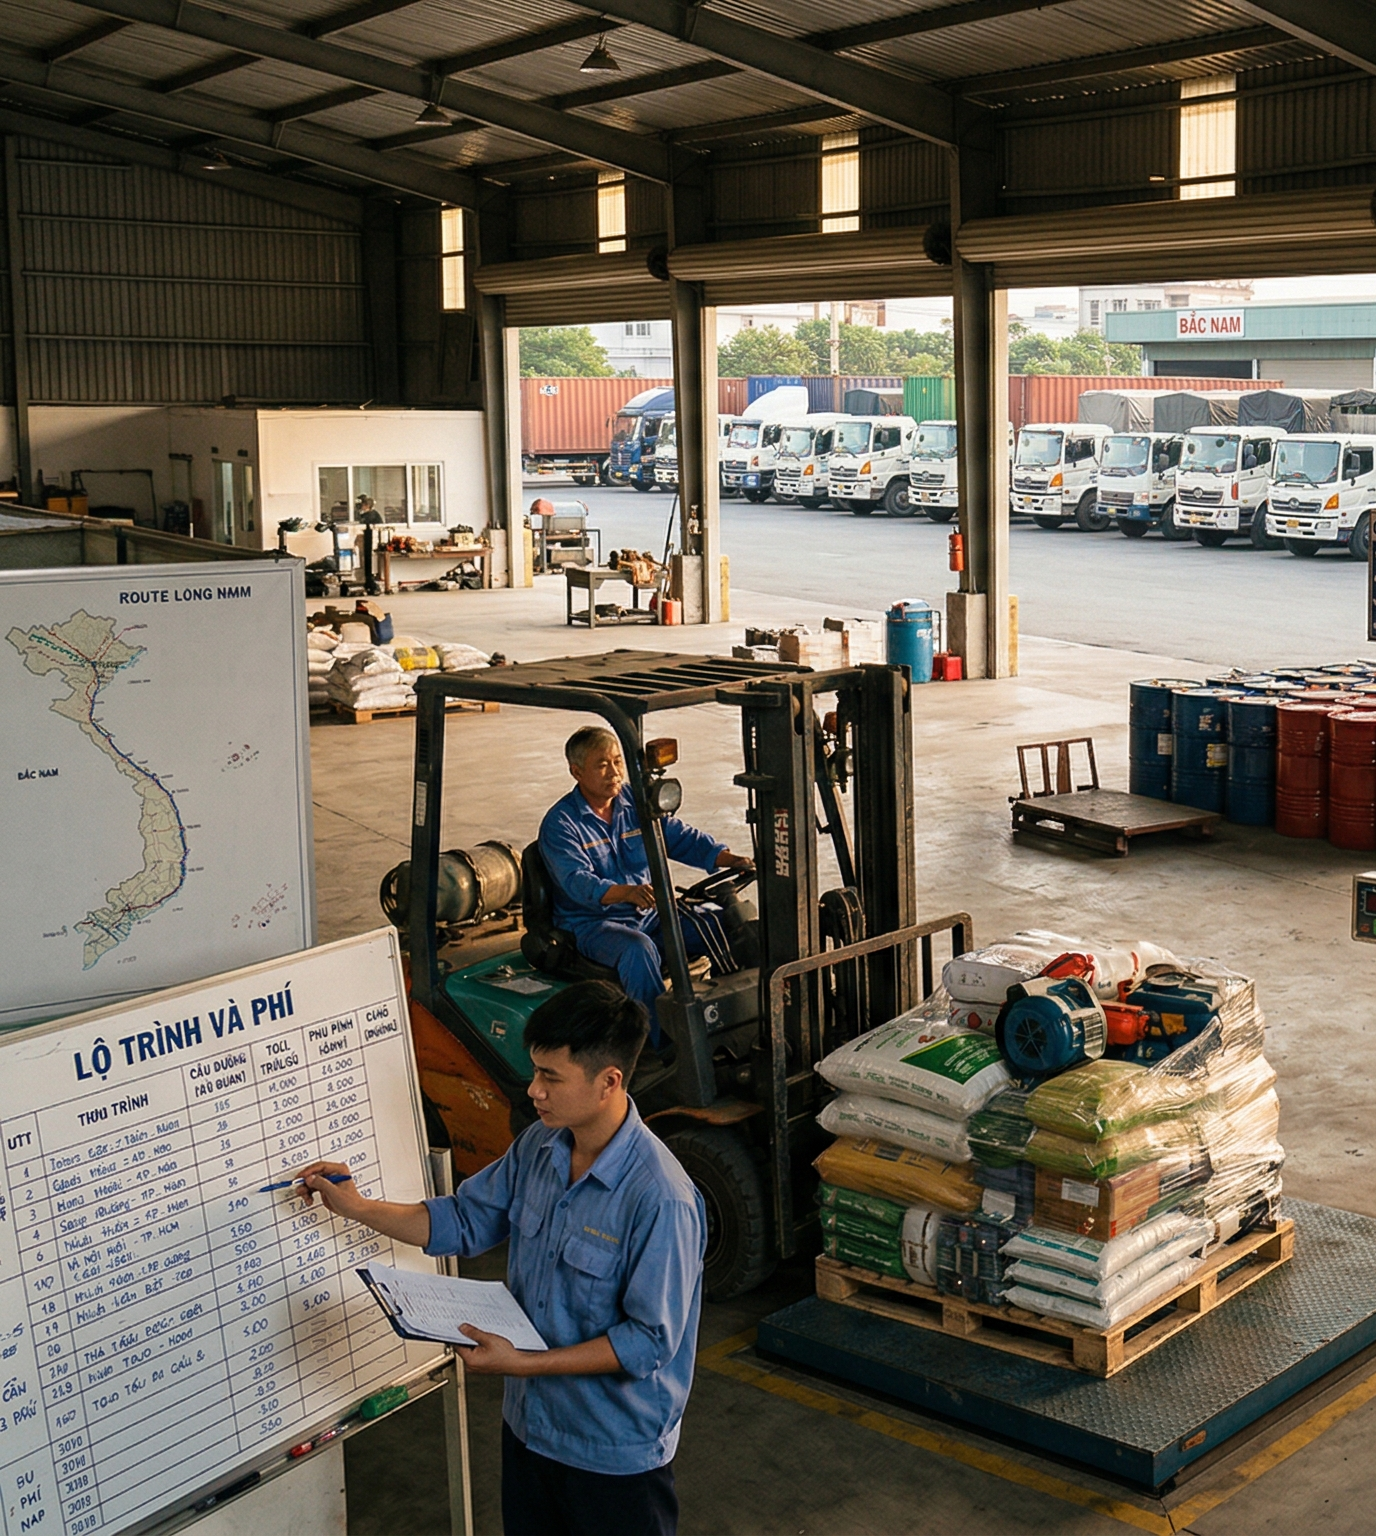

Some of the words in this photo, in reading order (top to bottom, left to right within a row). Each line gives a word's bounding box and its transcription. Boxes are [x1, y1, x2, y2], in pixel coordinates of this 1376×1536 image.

[1179, 310, 1207, 335] BẮC
[1210, 316, 1241, 334] NAM
[119, 590, 170, 605] ROUTE
[174, 588, 213, 602] LONG
[73, 1037, 112, 1081] LỘ
[118, 1016, 203, 1066] TRÌNH
[208, 998, 245, 1039] VÀ
[250, 981, 295, 1026] PHÍ
[7, 1131, 32, 1150] UTT
[25, 1189, 34, 1201] 2
[29, 1208, 37, 1221] 3
[32, 1229, 40, 1241] 4
[36, 1250, 44, 1262] 6
[20, 1484, 42, 1510] PHÍ
[20, 1509, 45, 1533] NAP
